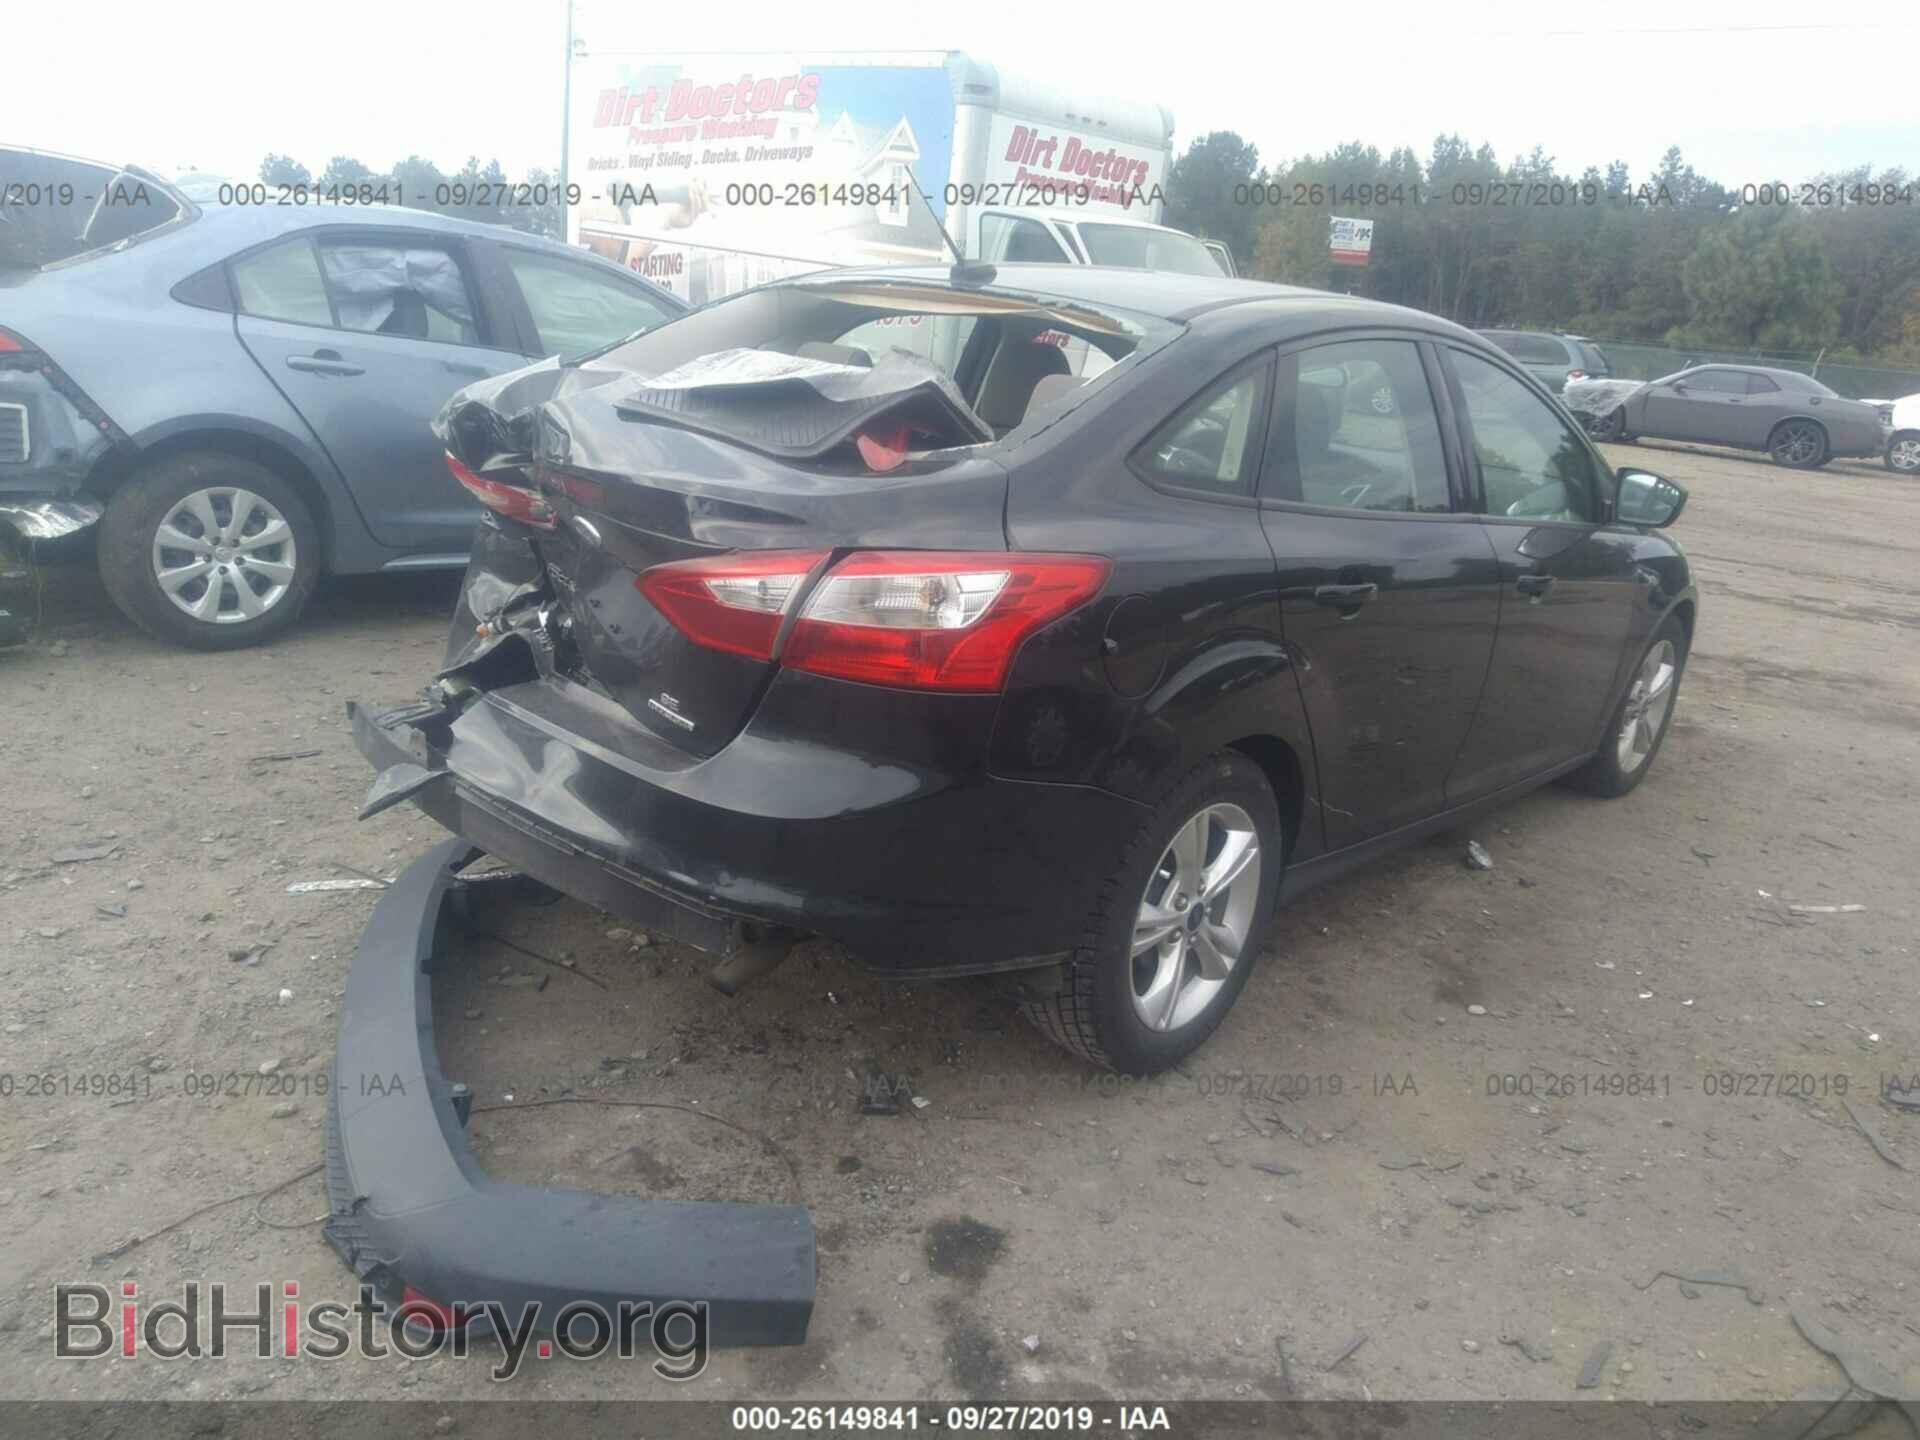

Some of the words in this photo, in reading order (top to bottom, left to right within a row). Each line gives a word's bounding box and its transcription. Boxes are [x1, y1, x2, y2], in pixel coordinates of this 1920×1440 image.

[594, 84, 658, 128] Dirt
[664, 73, 822, 122] Doctors
[627, 152, 655, 172] Vinyl
[656, 149, 692, 170] Siding
[745, 145, 814, 164] Driveways
[1004, 124, 1058, 168] Dirt
[1058, 136, 1150, 187] Doctors
[631, 252, 683, 277] STARTING
